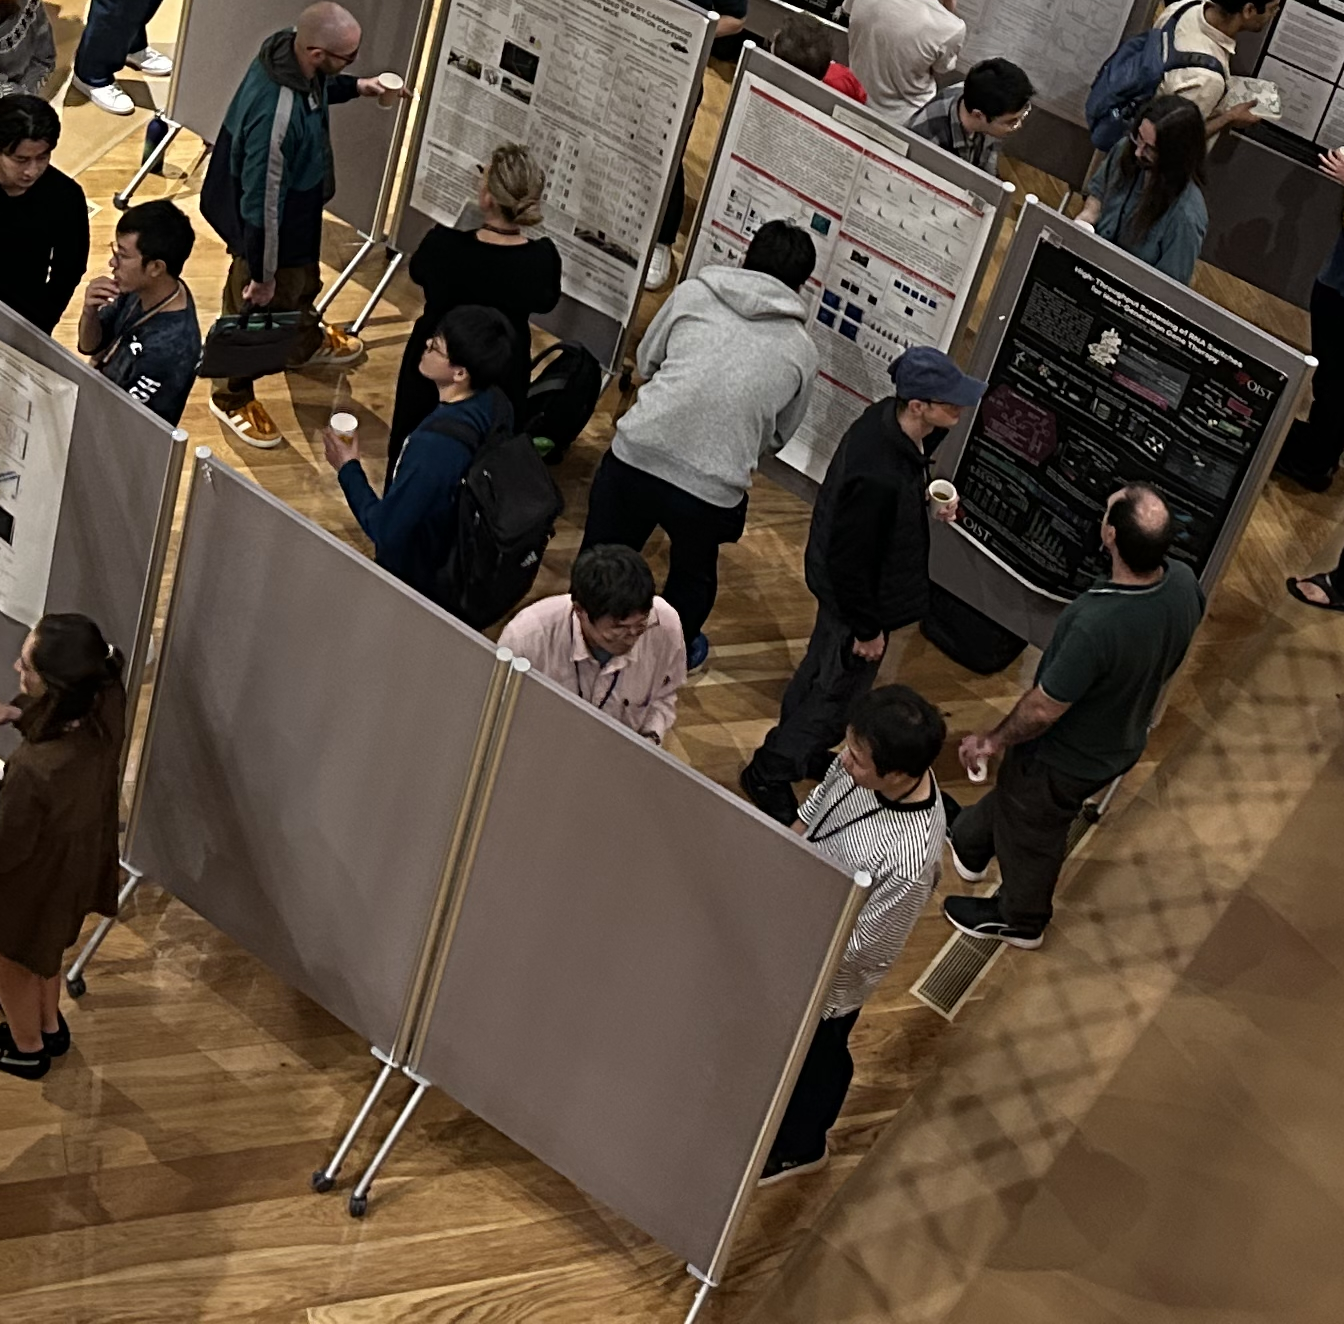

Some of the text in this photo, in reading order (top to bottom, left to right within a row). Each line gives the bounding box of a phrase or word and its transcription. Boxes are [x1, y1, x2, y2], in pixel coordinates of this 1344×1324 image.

[1089, 283, 1219, 365] for Next-Generation Gene Therapy
[1139, 305, 1177, 331] Screening
[1178, 327, 1188, 336] of
[1187, 332, 1206, 347] RNA
[1206, 343, 1243, 368] Switches
[1246, 379, 1275, 401] OIST
[963, 516, 993, 542] OIST
